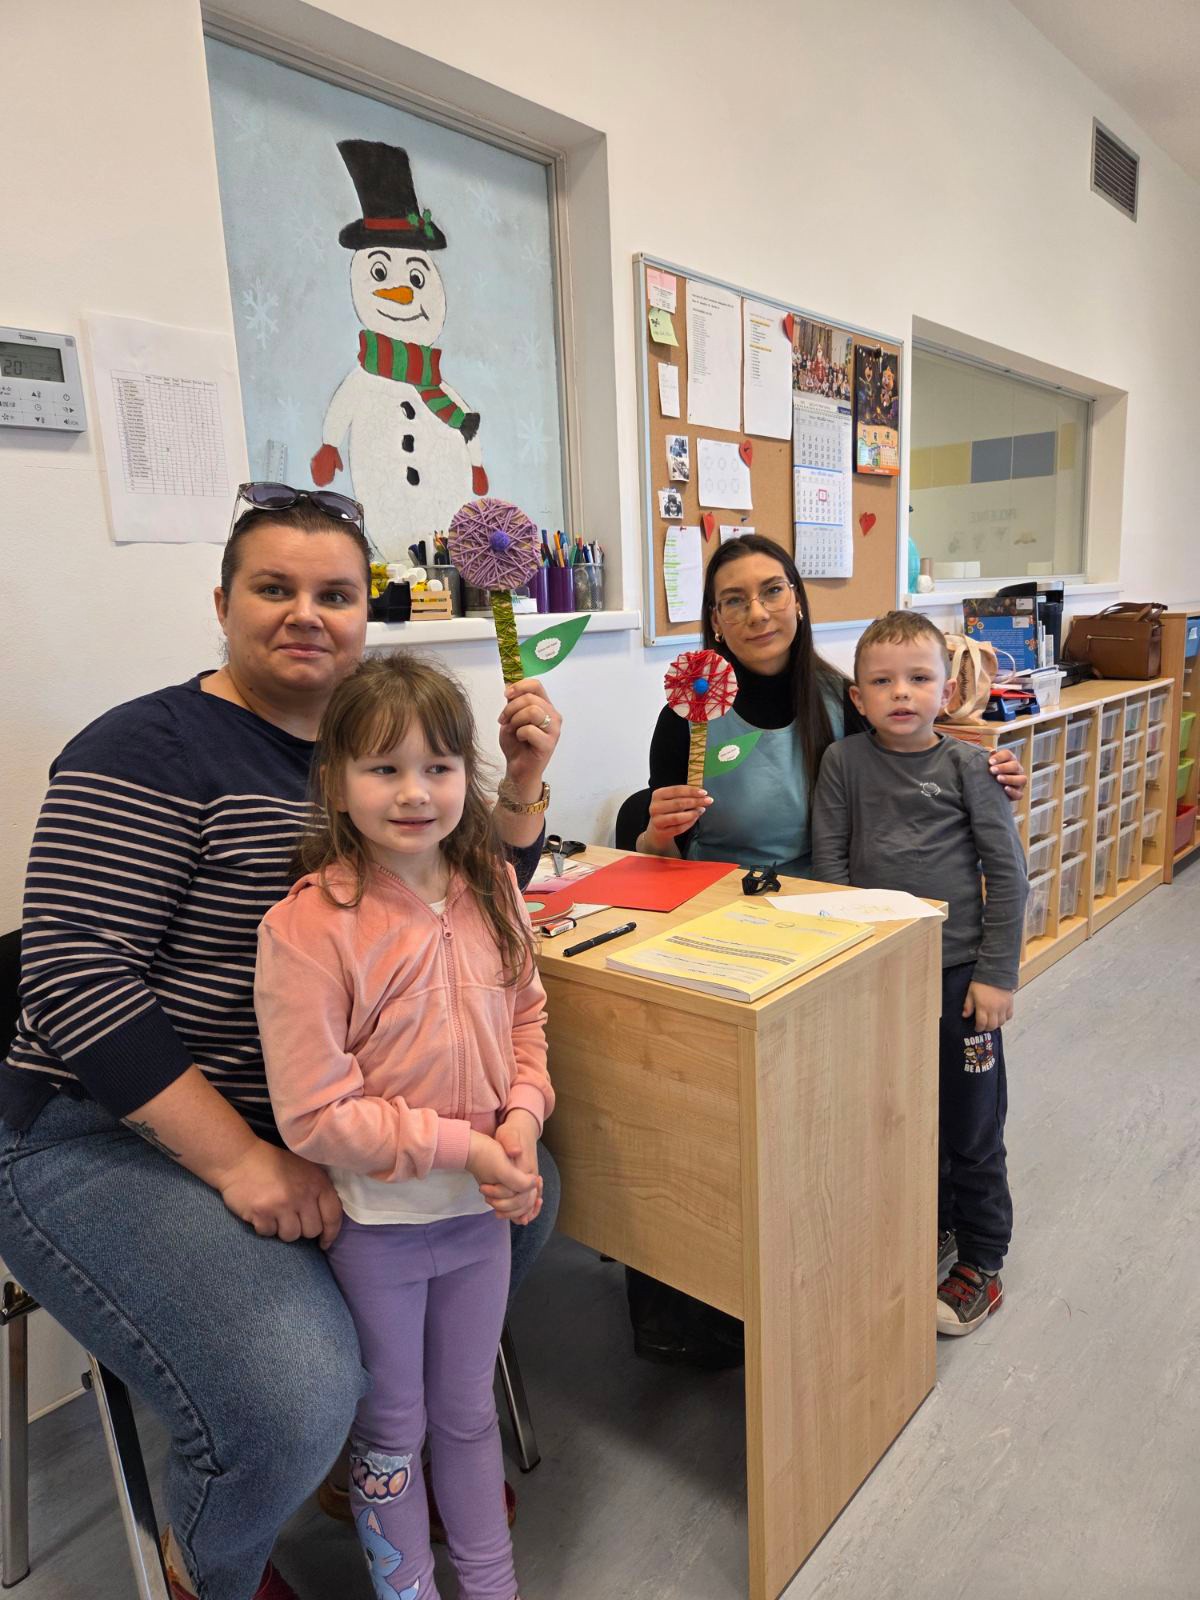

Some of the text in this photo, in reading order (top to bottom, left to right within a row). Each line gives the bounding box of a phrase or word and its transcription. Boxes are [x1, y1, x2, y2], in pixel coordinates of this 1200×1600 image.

[4, 359, 22, 376] 20
[964, 1032, 991, 1046] BORN TO
[964, 1058, 996, 1073] BE A HERO
